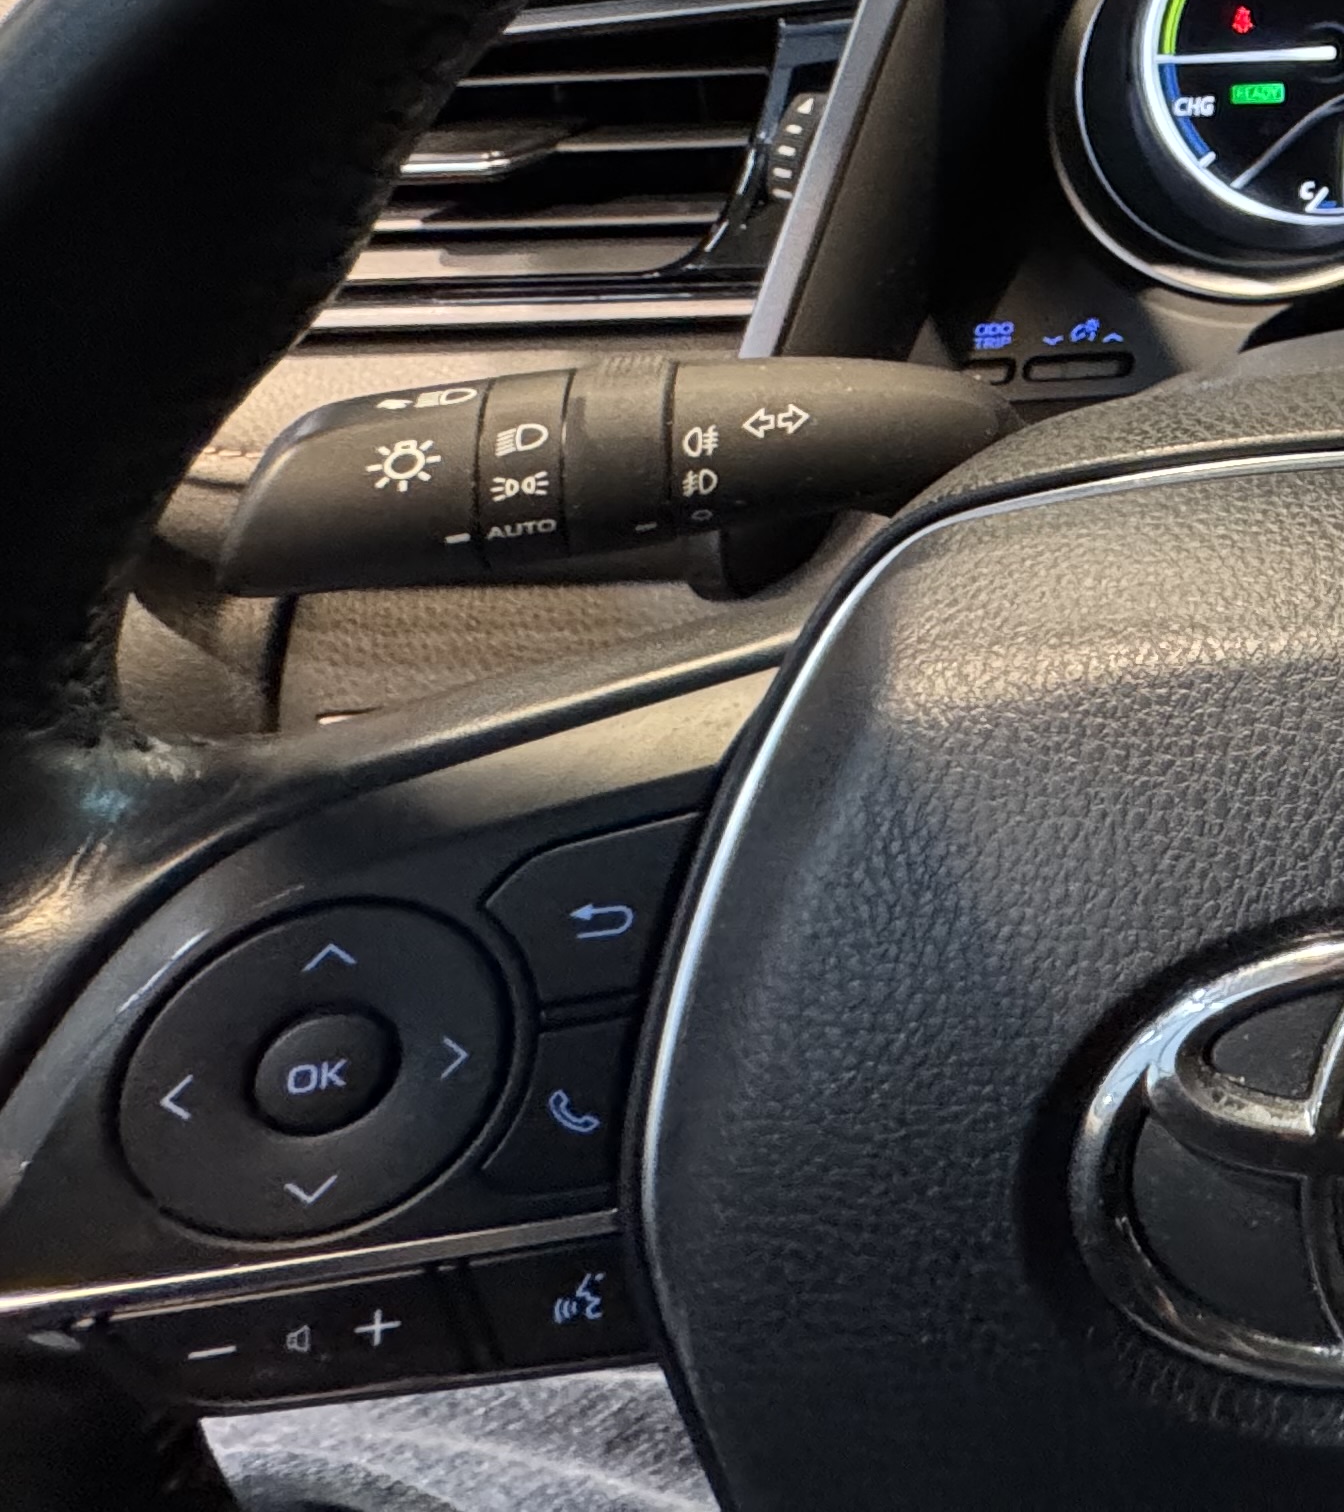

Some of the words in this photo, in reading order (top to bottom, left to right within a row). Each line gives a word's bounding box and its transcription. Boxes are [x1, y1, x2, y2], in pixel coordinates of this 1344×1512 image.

[1173, 96, 1215, 118] CHG
[974, 320, 1015, 337] ODO
[973, 335, 1013, 350] TRIP
[486, 518, 557, 541] AUTO
[286, 1058, 347, 1096] OK
